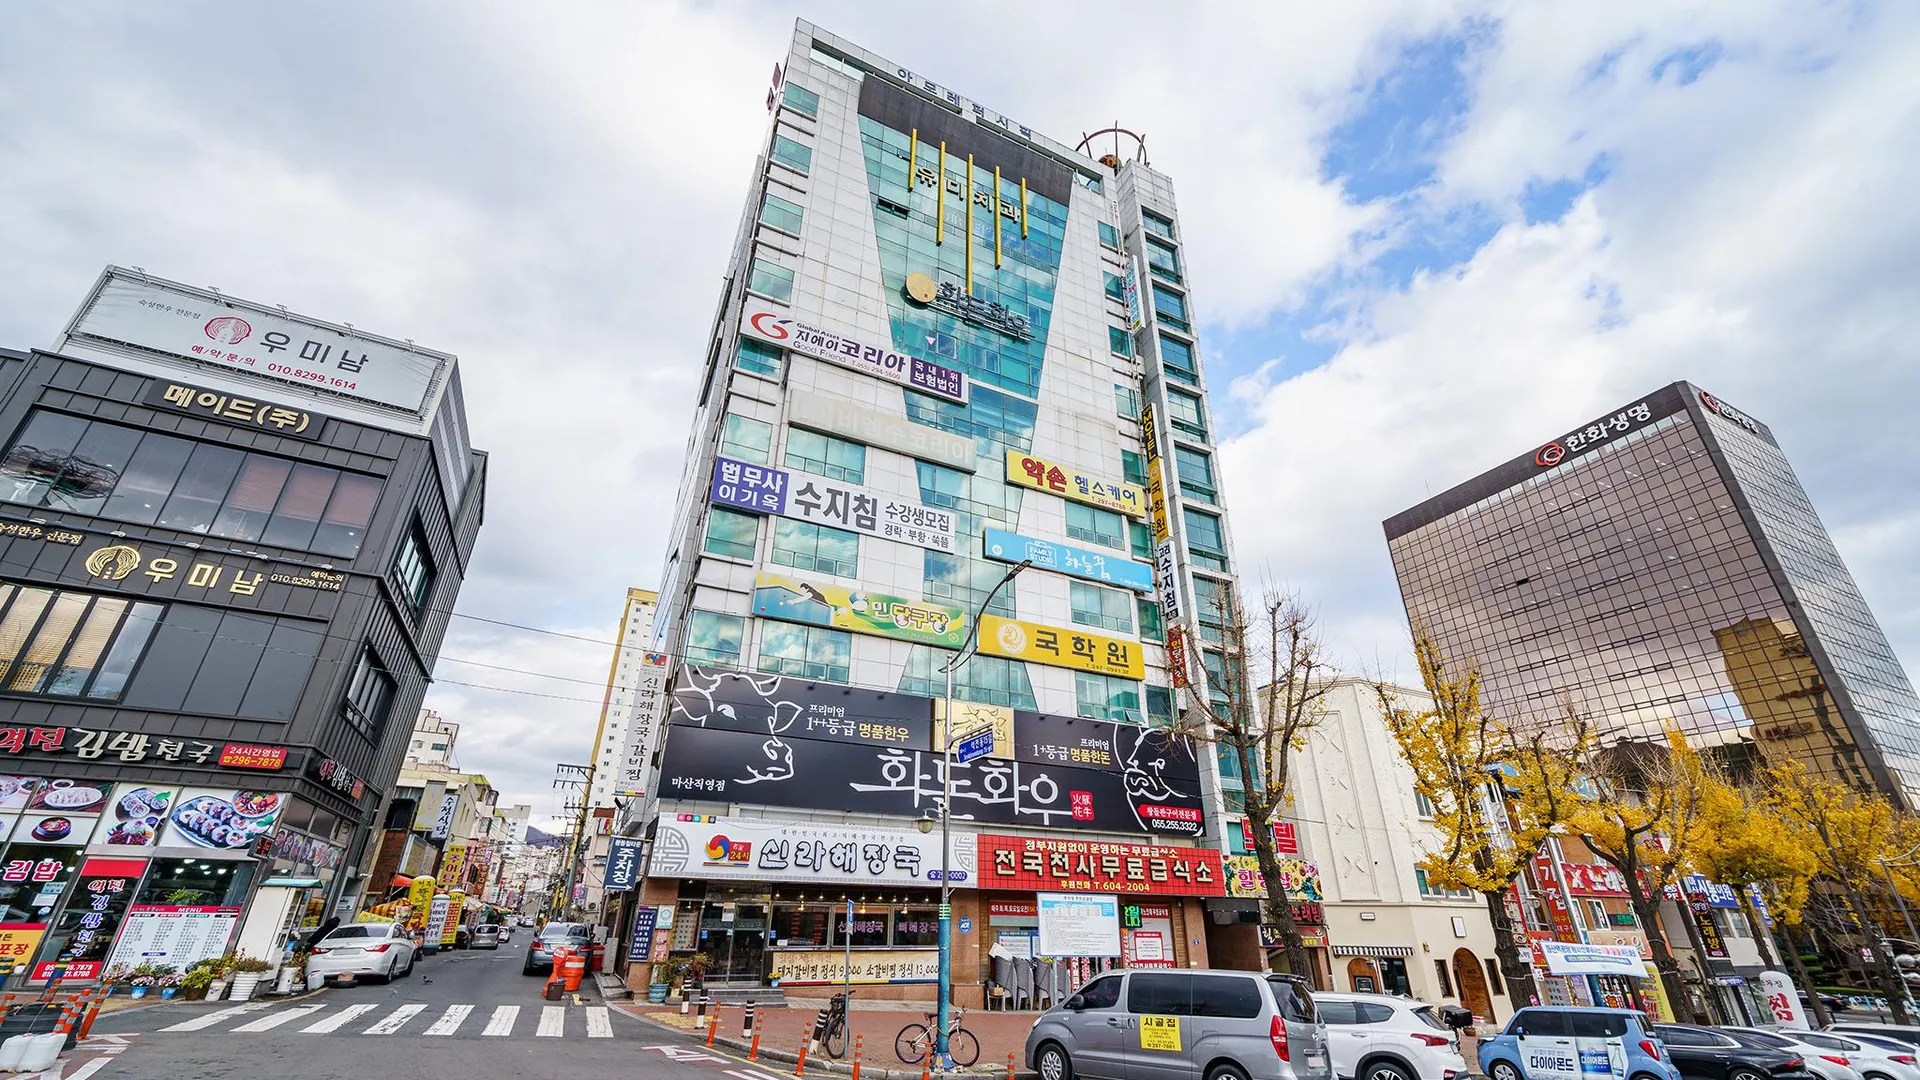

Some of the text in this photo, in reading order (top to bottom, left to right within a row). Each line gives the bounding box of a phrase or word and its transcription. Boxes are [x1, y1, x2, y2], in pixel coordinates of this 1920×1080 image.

[797, 323, 840, 341] Global Asset
[191, 344, 256, 367] 예/약/문/의
[259, 331, 369, 374] 우미남
[793, 341, 847, 363] Good Friend
[796, 329, 906, 373] 지에이코리아
[268, 363, 357, 391] 010.8299.1614
[914, 372, 959, 394] 보험법인
[163, 384, 310, 433] 메이드(주)
[1143, 412, 1157, 460] MOTEL
[1565, 402, 1651, 453] 한화생명
[721, 461, 783, 494] 법무사
[1021, 457, 1137, 506] 약손 헬스케어
[718, 485, 780, 511] 이기옥
[795, 482, 878, 531] 수지침
[1151, 480, 1166, 534] 국학원
[885, 501, 950, 532] 수강생모집
[1029, 547, 1053, 557] FAMILY
[1029, 554, 1054, 565] STUDIO
[145, 558, 265, 596] 우미남
[270, 572, 341, 592] 010.8299.1614
[1035, 629, 1129, 669] 국학원
[808, 703, 846, 718] 프리미엄
[806, 716, 910, 742] 1++등급 명품한우
[72, 727, 214, 763] 김밥천국
[229, 746, 282, 759] 24시간영업
[1033, 743, 1112, 765] 1+등급 명품한돈
[1080, 737, 1110, 751] 프리미엄
[231, 756, 281, 768] 296-7878
[671, 777, 726, 792] 마산직영점
[1152, 818, 1198, 832] 055.255.3322
[730, 850, 750, 860] 24시
[758, 838, 921, 877] 신라해장국
[1025, 839, 1178, 860] 정부지원없이 운영하는 무료급식소
[3, 860, 63, 881] 김밥
[612, 847, 636, 884] 주차장
[995, 849, 1214, 883] 전국천사무료급식소
[1094, 881, 1150, 892] T.604-2004
[1700, 915, 1720, 950] 노래방
[821, 964, 837, 980] 정식
[1143, 1017, 1176, 1028] 시골집
[1530, 1055, 1575, 1072] 다이아몬드
[1581, 1056, 1609, 1065] 다이아몬드
